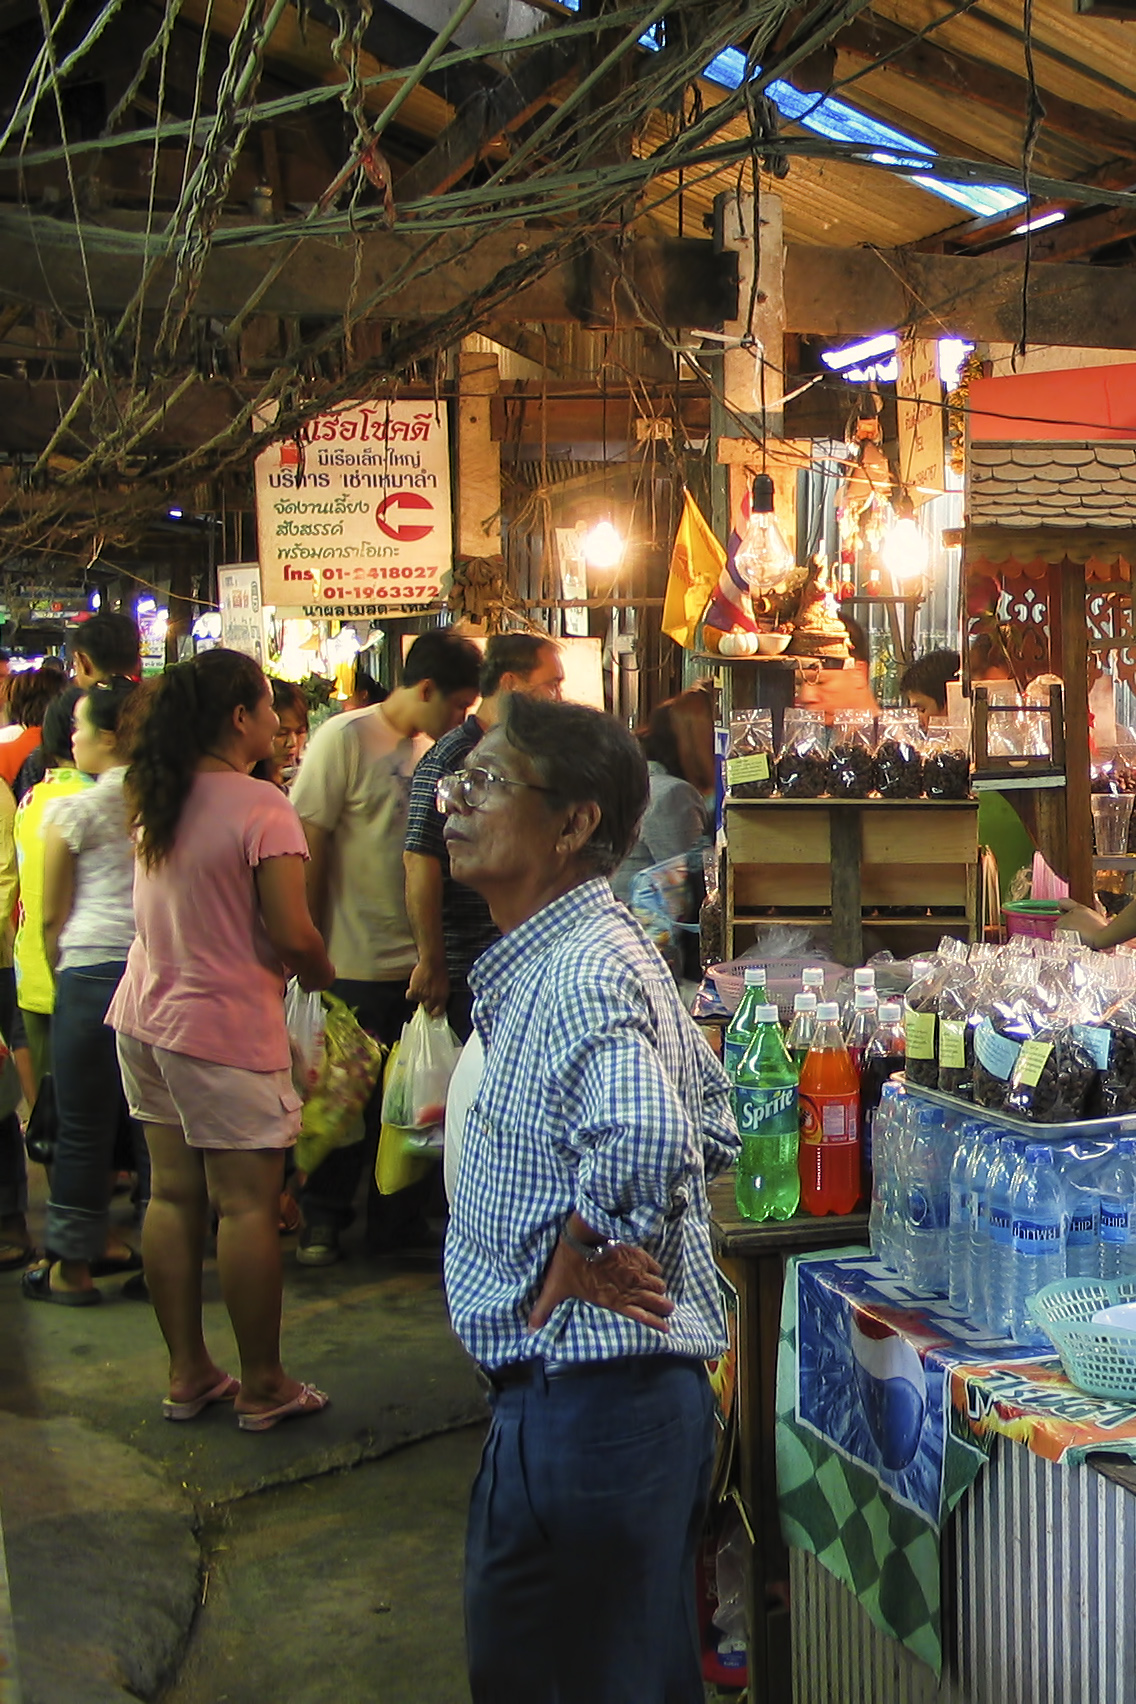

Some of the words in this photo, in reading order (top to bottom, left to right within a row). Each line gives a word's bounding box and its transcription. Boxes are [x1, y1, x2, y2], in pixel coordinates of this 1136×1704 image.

[274, 493, 370, 514] จัดงานเลี้ยง
[276, 519, 344, 537] สังสรรค์
[277, 541, 400, 560] พร้อมคาราโอเกะ
[322, 566, 438, 581] 01-2418027
[323, 585, 439, 600] 01-1963372
[742, 1089, 793, 1130] Sprite
